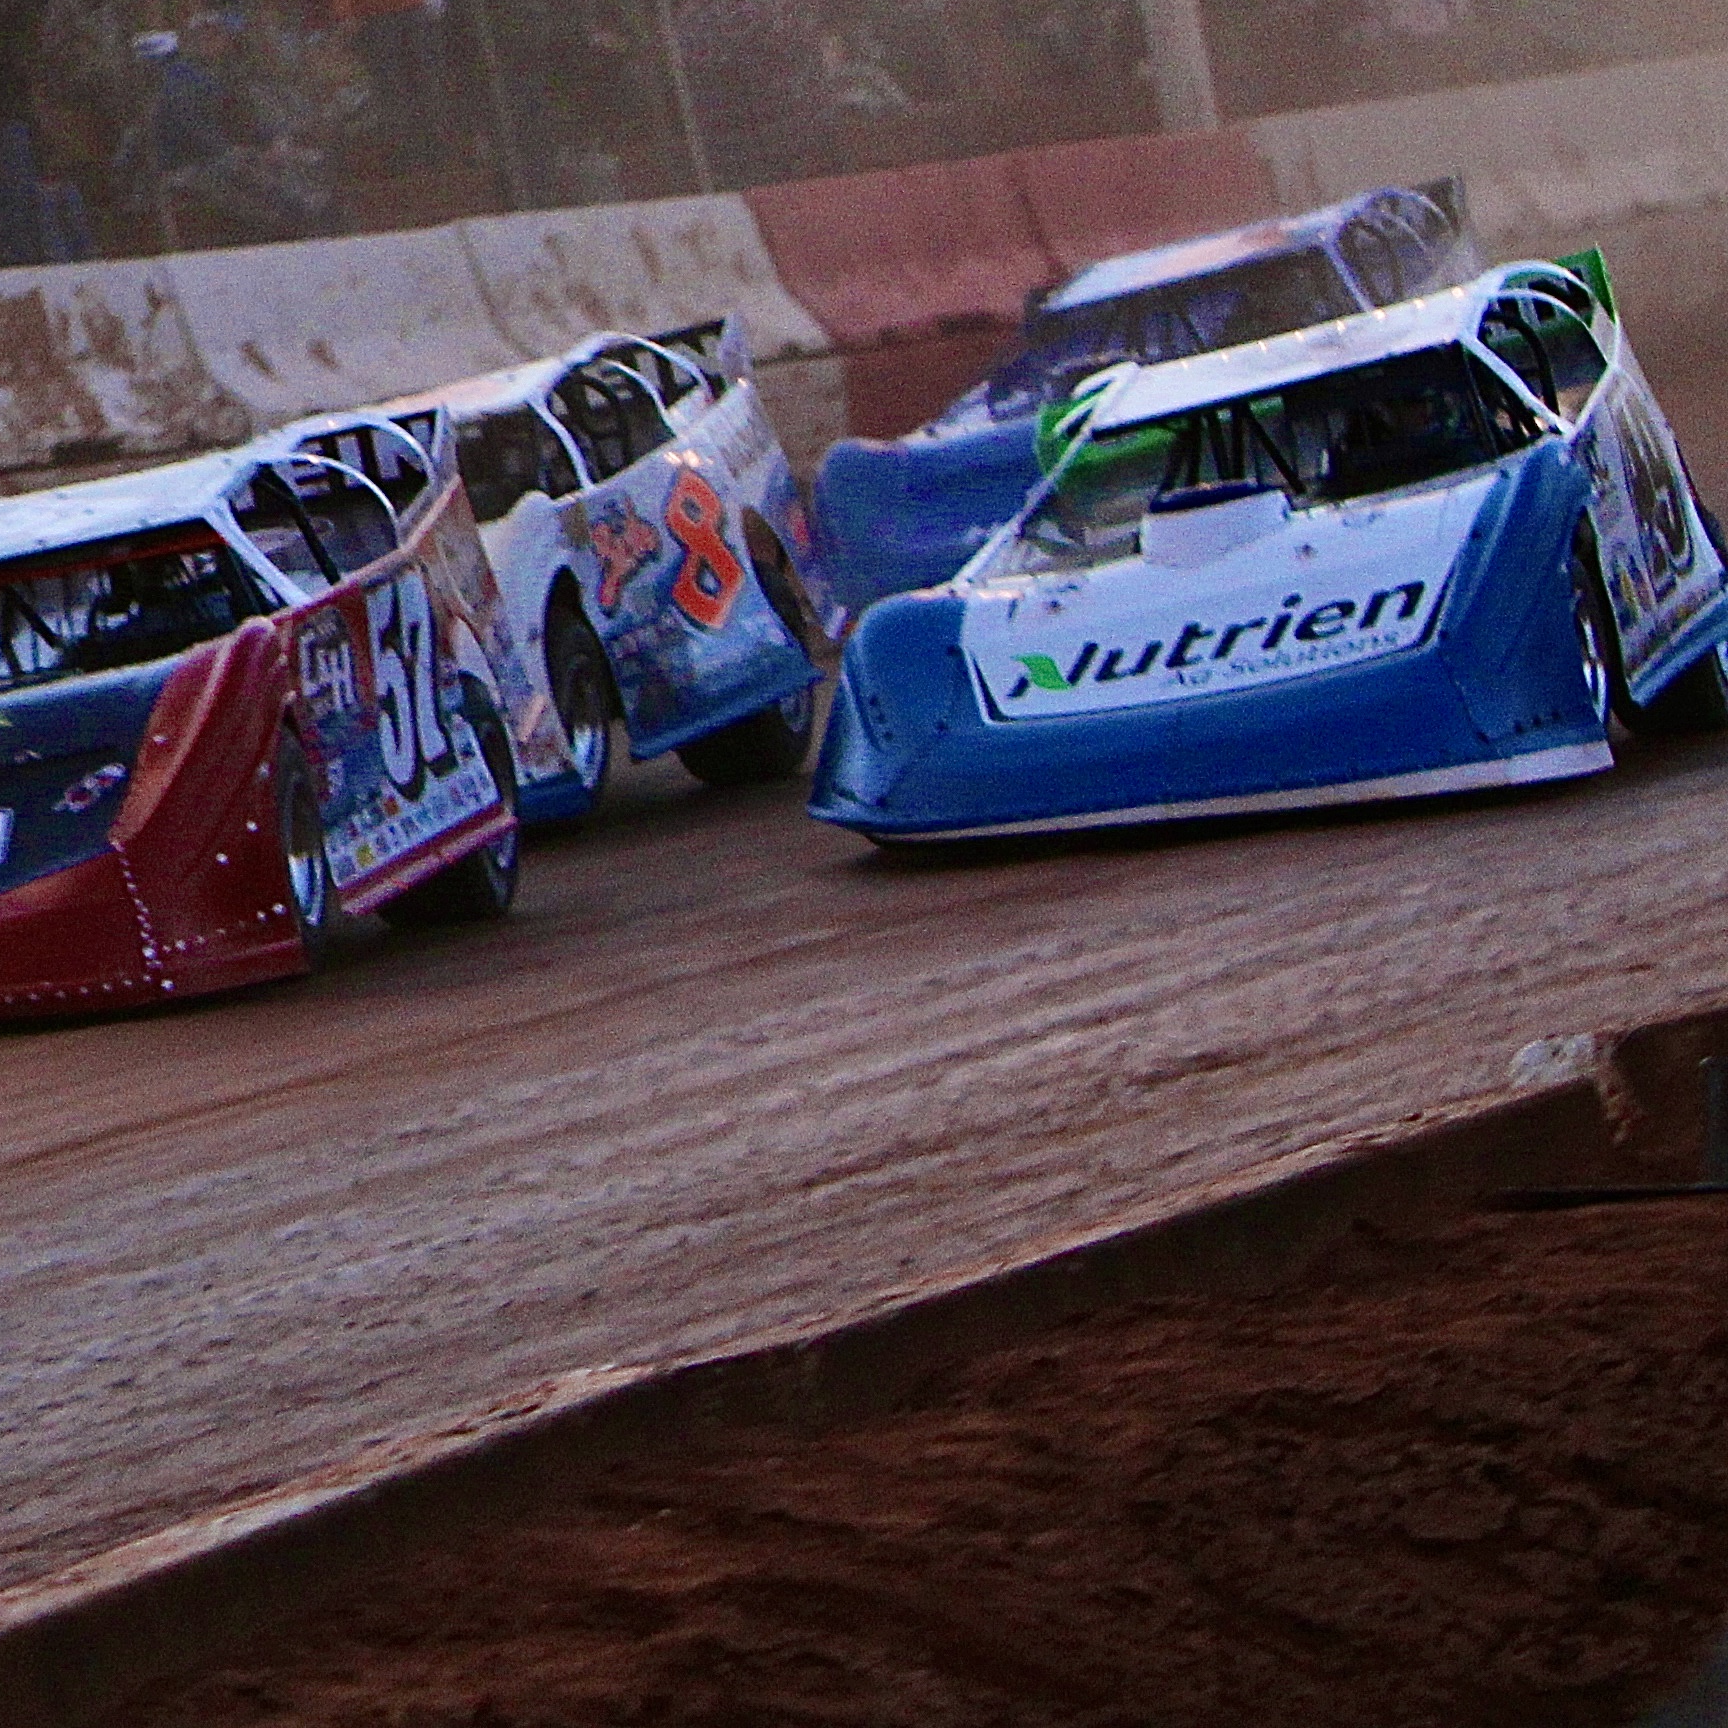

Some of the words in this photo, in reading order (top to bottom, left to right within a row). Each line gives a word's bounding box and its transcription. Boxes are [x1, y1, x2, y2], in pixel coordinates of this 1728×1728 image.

[665, 469, 745, 630] 8
[365, 568, 451, 792] 57
[1007, 580, 1426, 698] Nutrien
